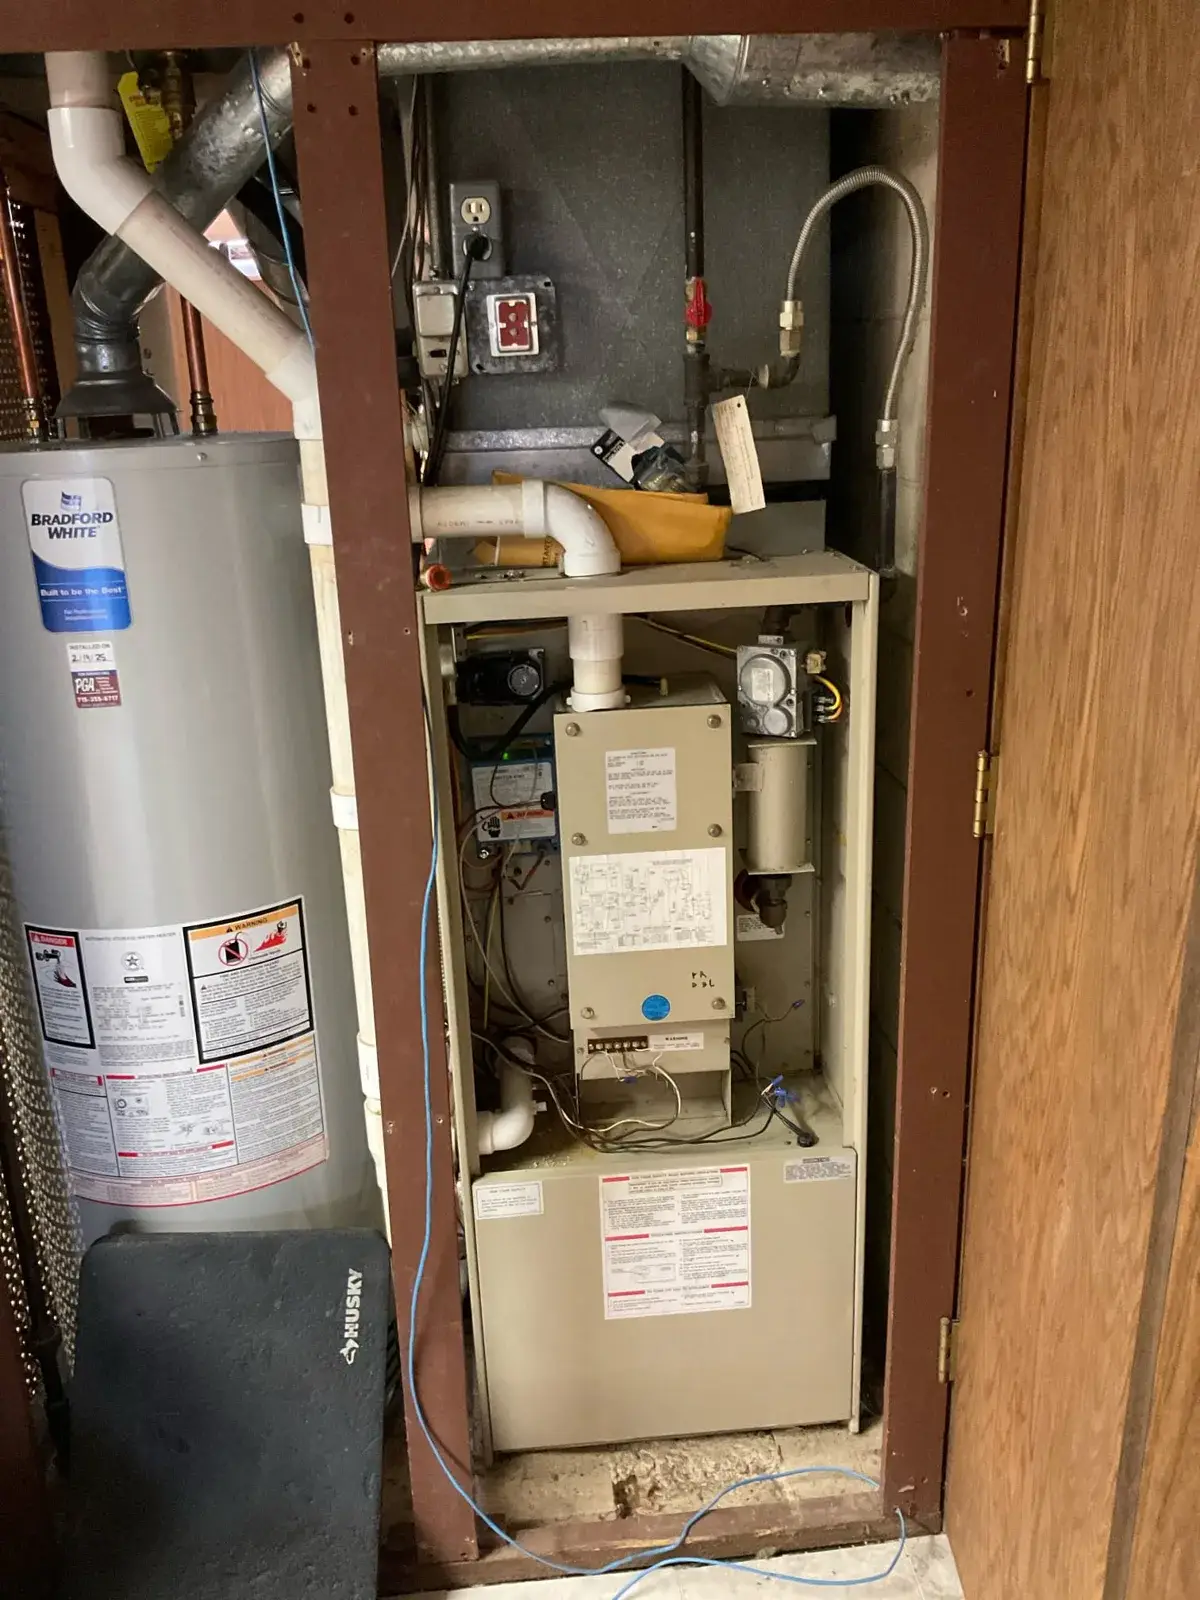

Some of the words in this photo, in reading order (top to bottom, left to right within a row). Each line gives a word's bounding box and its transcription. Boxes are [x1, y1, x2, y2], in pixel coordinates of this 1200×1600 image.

[31, 511, 114, 527] BRADFORD
[48, 526, 97, 540] WHITE
[41, 589, 58, 597] Built
[71, 588, 82, 596] be
[101, 586, 122, 595] Best
[75, 677, 95, 694] PGA
[235, 917, 268, 931] WARNING
[40, 936, 68, 946] DANGER
[344, 1268, 362, 1338] HUSKY
